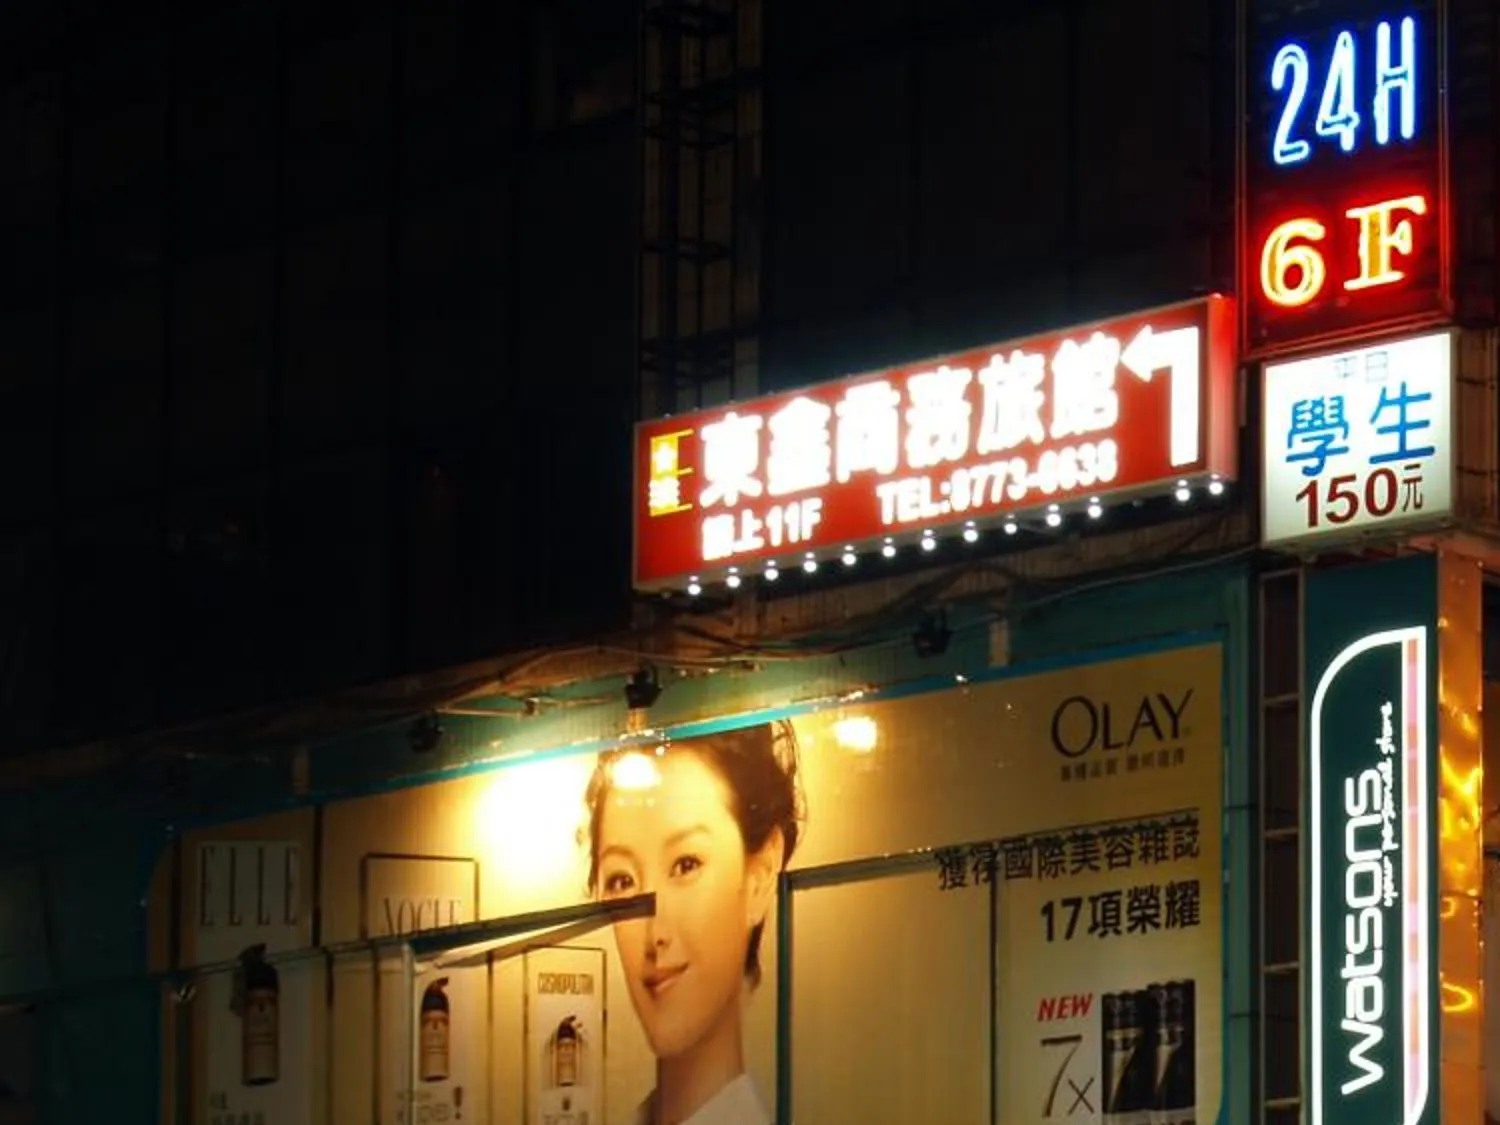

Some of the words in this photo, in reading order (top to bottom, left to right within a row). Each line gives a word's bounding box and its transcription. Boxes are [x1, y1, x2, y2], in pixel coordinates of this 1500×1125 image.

[1271, 16, 1415, 165] 24H
[1261, 195, 1426, 307] 6F
[1285, 381, 1435, 477] 學生
[1296, 463, 1423, 528] 150元
[1051, 688, 1194, 758] OLAY
[199, 845, 297, 927] ELLE
[1037, 993, 1094, 1022] NEW
